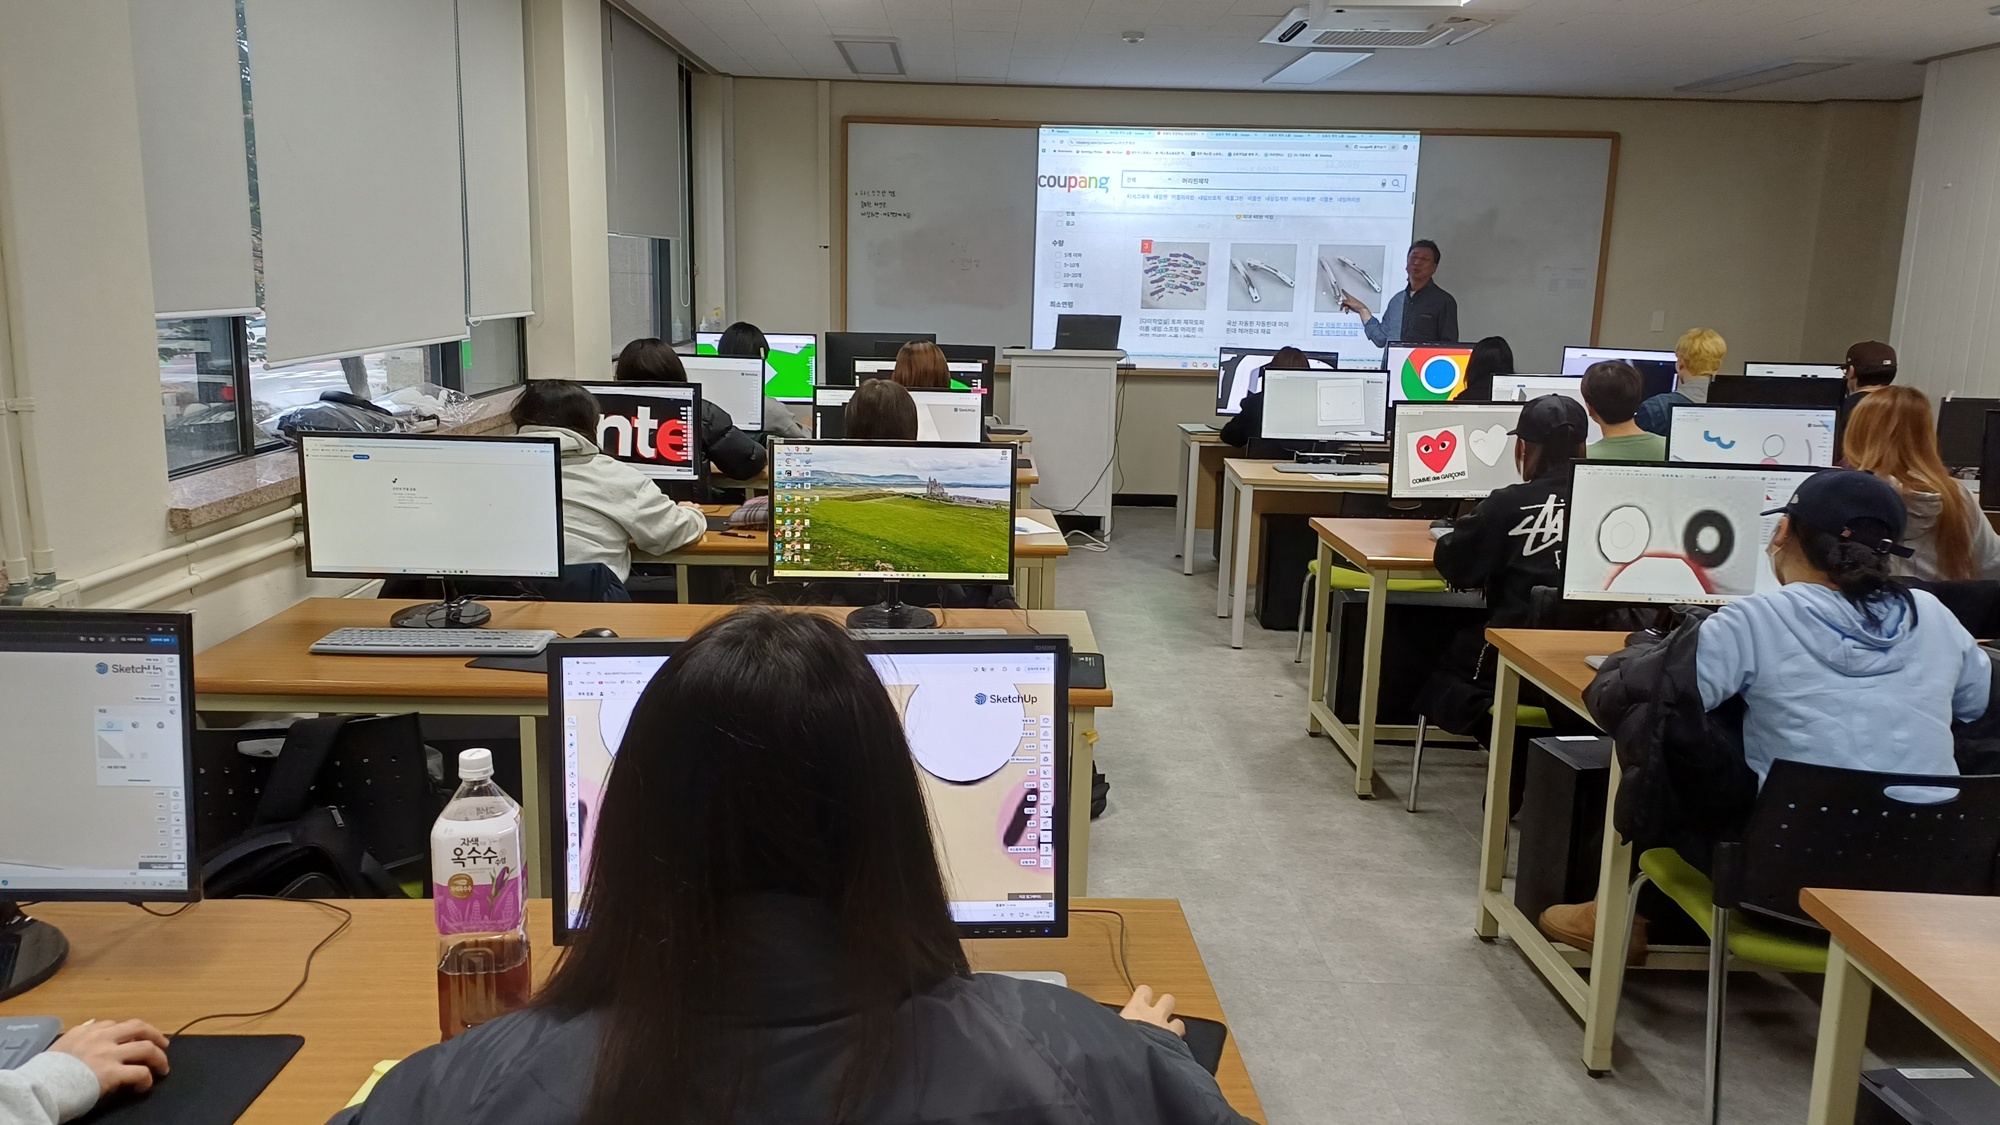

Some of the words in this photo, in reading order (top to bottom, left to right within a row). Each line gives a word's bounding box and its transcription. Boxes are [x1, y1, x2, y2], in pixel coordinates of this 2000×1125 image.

[1038, 174, 1110, 193] coupang
[1412, 476, 1431, 484] COMME
[1440, 470, 1466, 480] GARÇONS
[990, 694, 1038, 705] SketchUp
[460, 837, 479, 846] 자색
[451, 846, 498, 868] 옥수수
